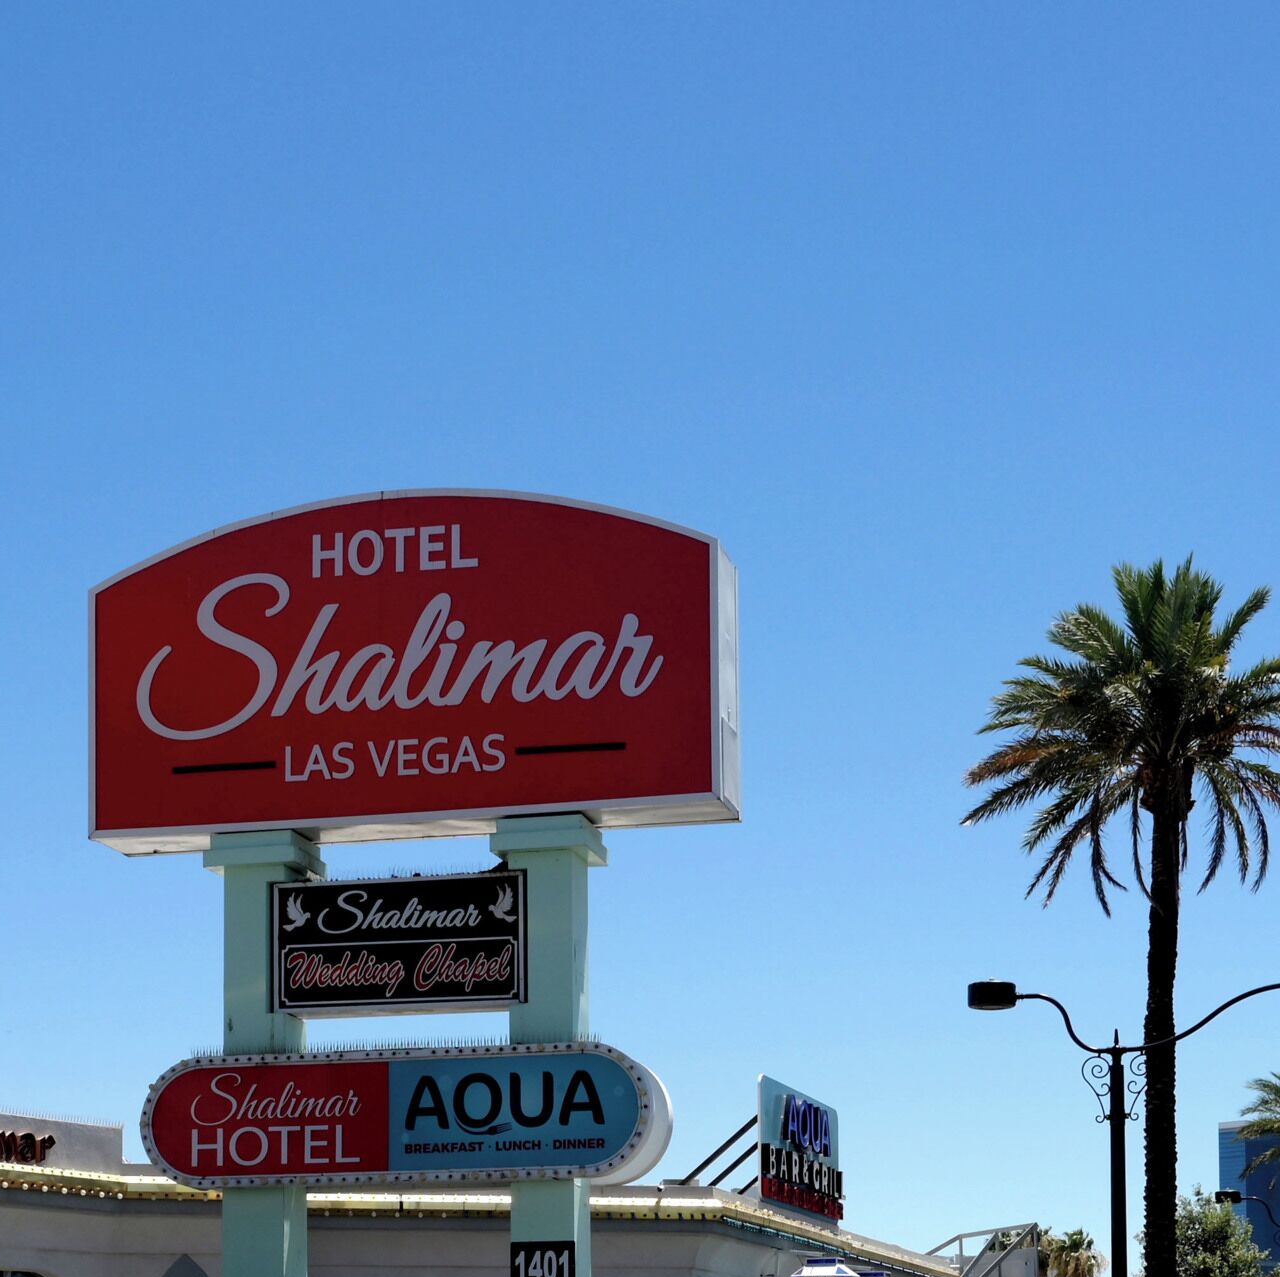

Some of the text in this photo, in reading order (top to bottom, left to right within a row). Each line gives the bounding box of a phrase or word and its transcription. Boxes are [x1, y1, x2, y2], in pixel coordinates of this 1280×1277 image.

[311, 524, 479, 578] HOTEL
[136, 572, 665, 740] Shalimar
[283, 733, 507, 783] LAS VEGAS
[317, 890, 483, 934] Shalimar
[287, 943, 512, 998] Wedding Chapel
[190, 1072, 362, 1126] Shalimar
[404, 1070, 606, 1133] AQUA
[787, 1095, 832, 1157] AQUA
[190, 1123, 361, 1168] HOTEL
[404, 1138, 605, 1154] BREAKFAST LUNCH DINNER
